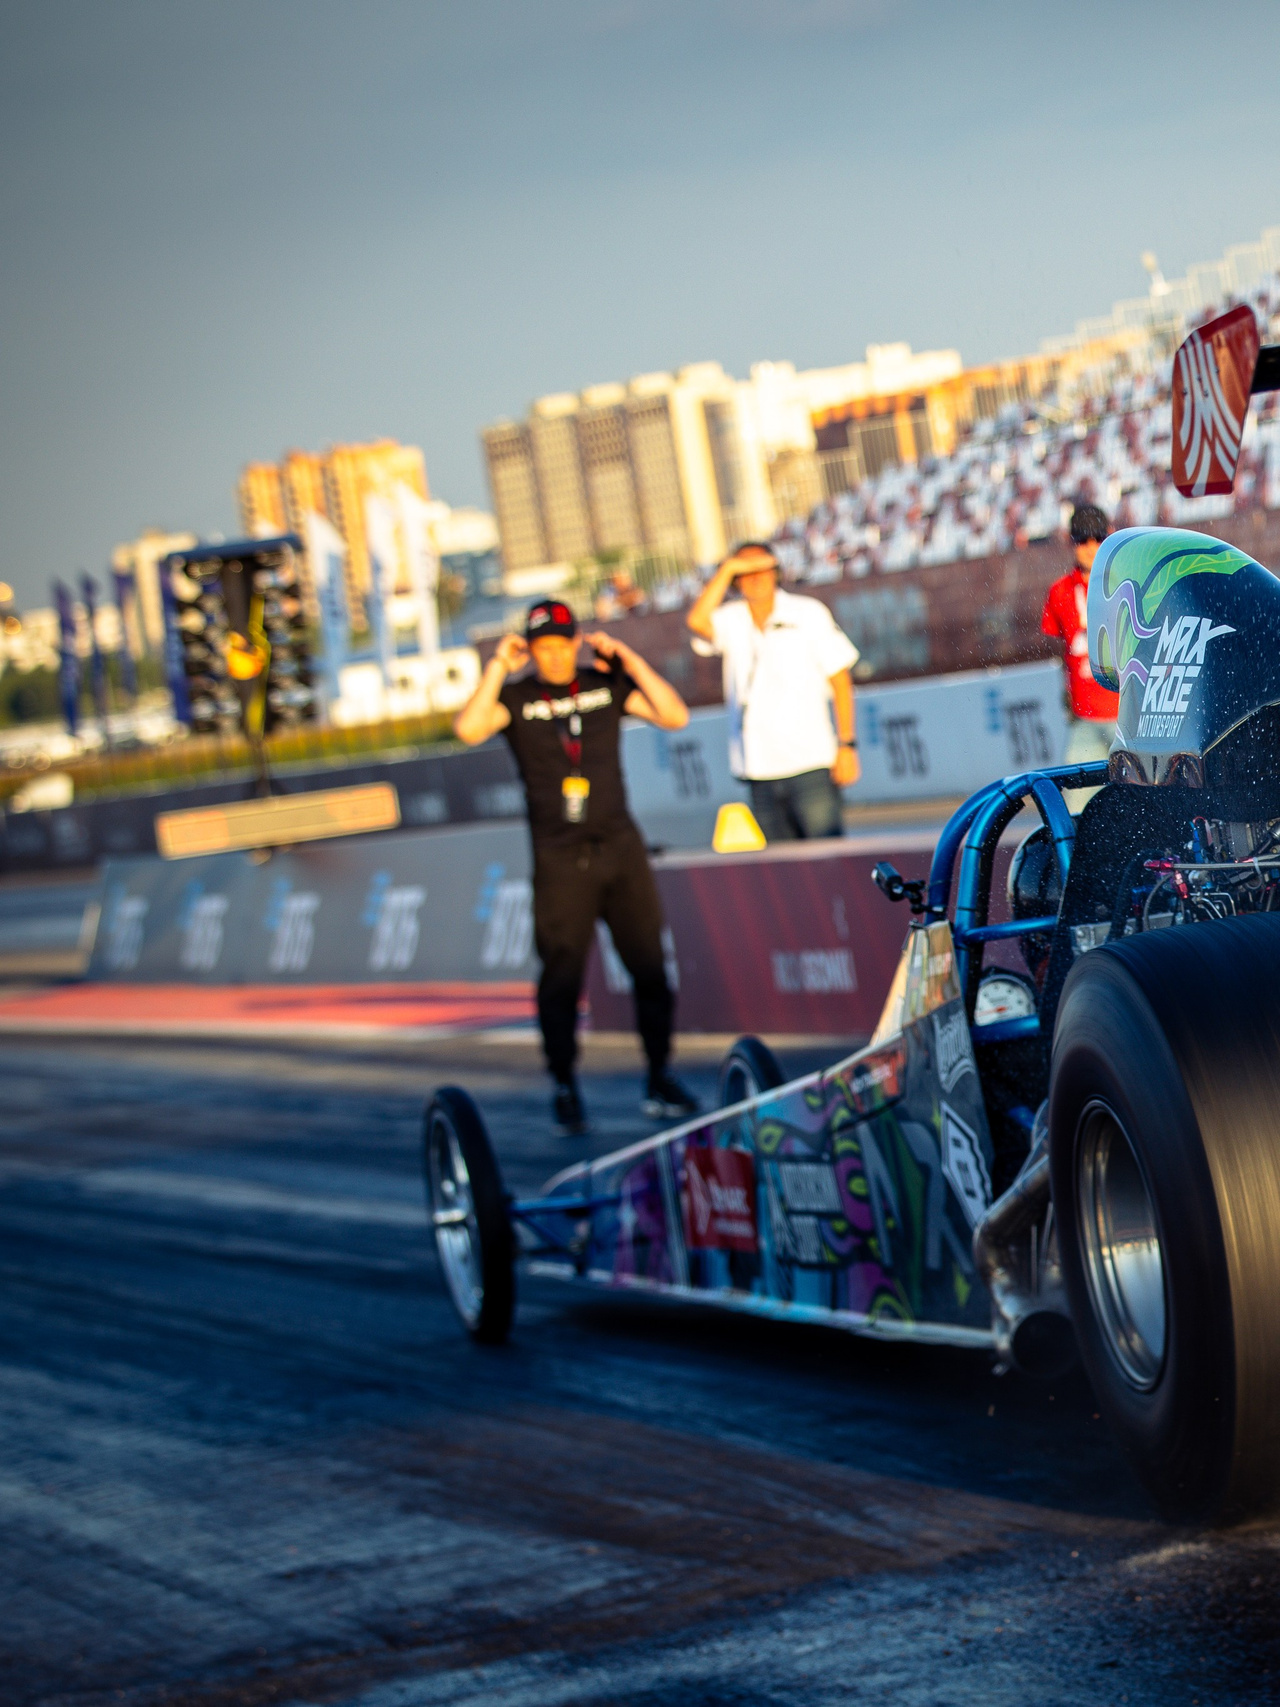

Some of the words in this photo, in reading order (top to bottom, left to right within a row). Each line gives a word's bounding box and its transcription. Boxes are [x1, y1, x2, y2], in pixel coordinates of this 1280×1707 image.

[1153, 616, 1236, 664] MAX
[1141, 665, 1201, 712] RIDE
[1137, 715, 1184, 737] MOTORSPORT
